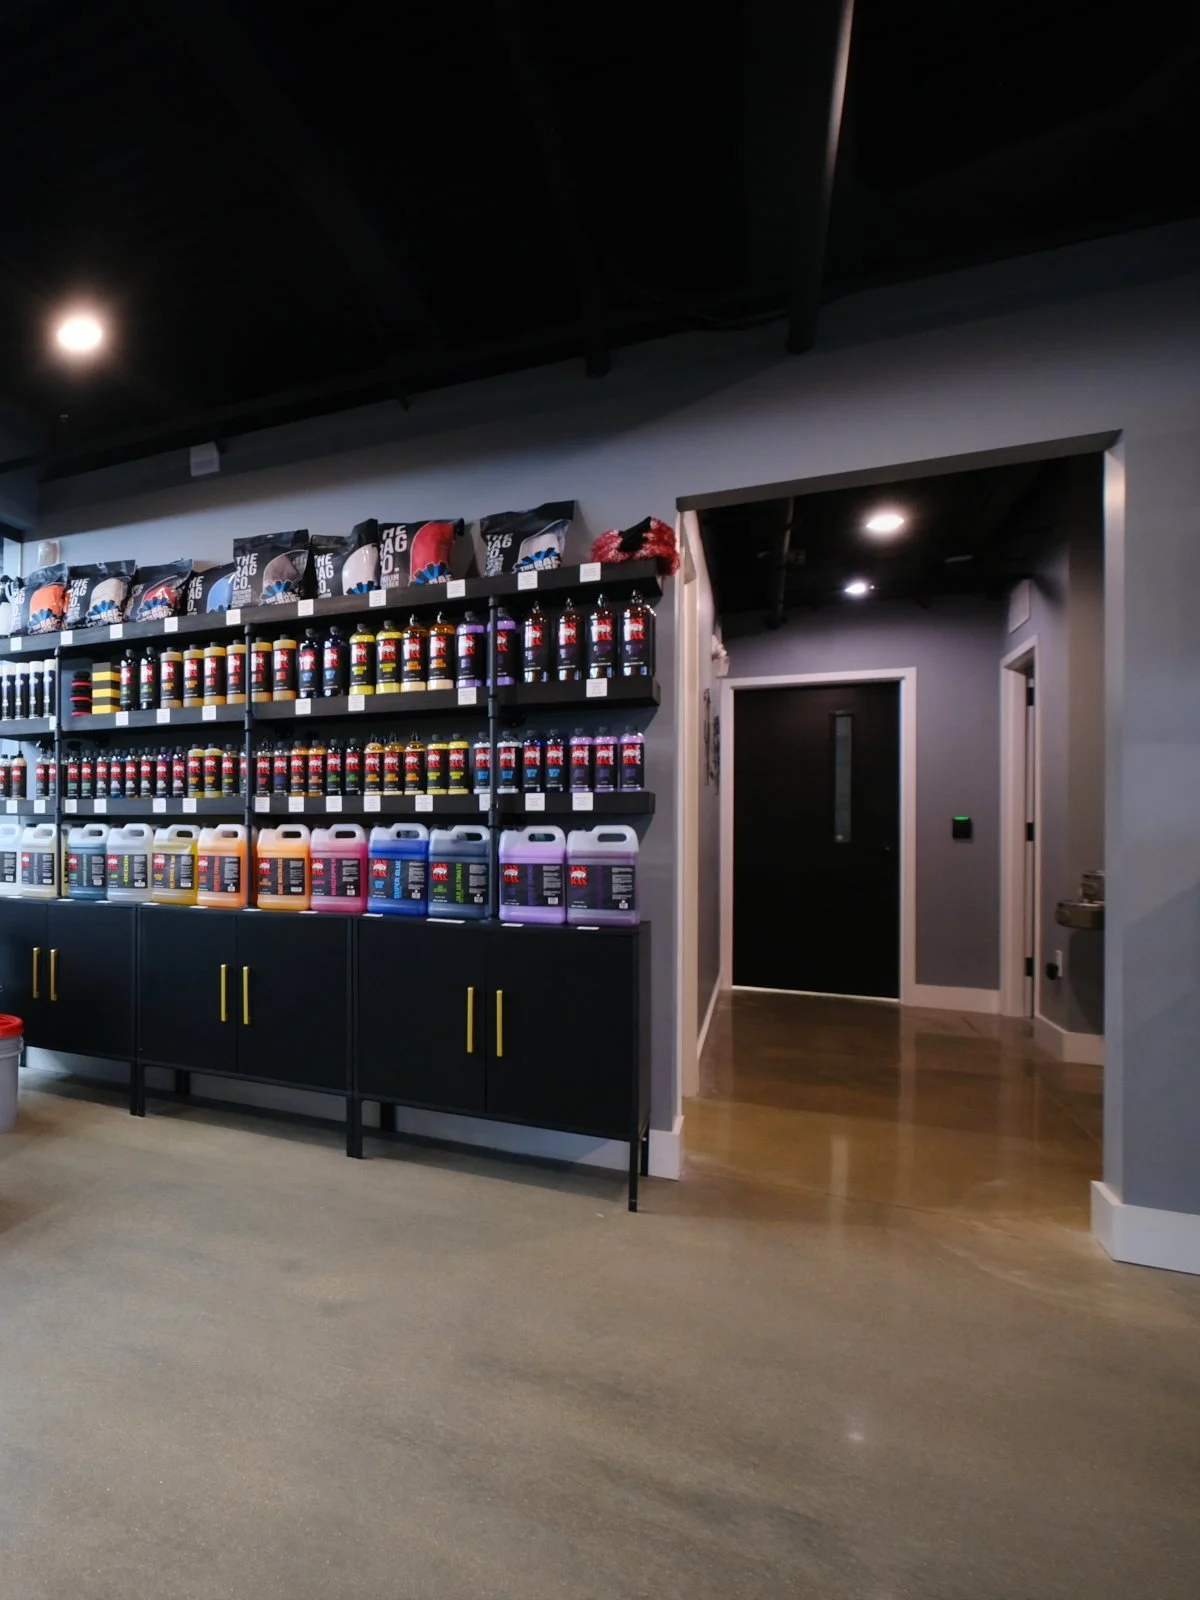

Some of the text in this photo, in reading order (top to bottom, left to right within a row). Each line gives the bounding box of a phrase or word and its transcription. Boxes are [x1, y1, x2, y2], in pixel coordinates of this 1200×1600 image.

[382, 524, 407, 541] HE
[235, 552, 259, 565] THE
[235, 563, 258, 578] RAG
[316, 566, 334, 581] AG
[189, 575, 205, 587] HE
[233, 577, 252, 591] CO.
[318, 580, 331, 594] O.
[70, 586, 88, 597] AG
[188, 587, 203, 600] AG
[393, 877, 401, 899] SUPER
